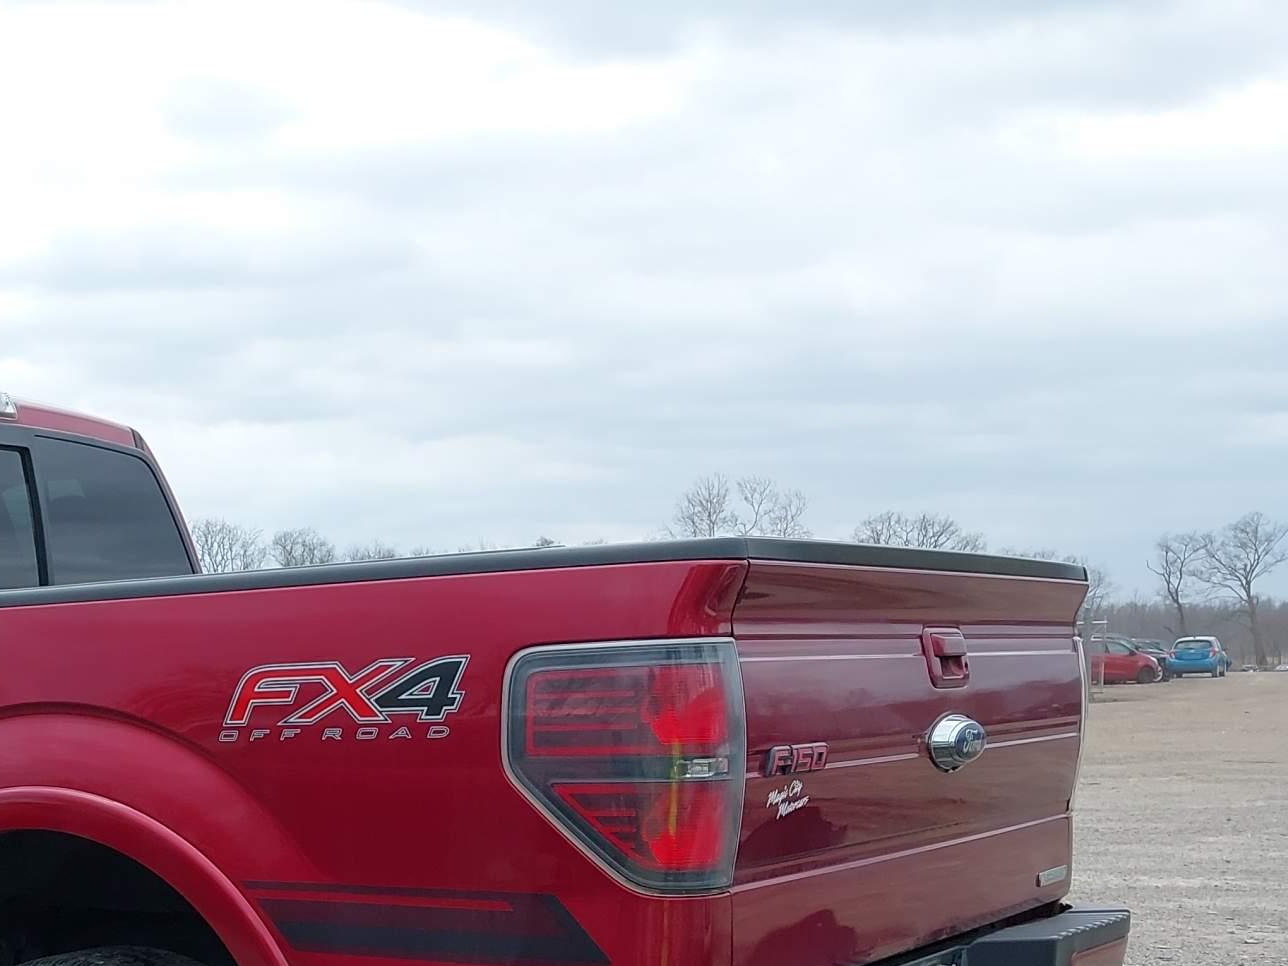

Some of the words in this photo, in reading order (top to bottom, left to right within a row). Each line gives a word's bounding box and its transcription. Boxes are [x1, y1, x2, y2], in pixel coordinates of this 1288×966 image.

[223, 654, 471, 727] FX4
[218, 728, 303, 742] OFF
[321, 725, 451, 741] ROAD
